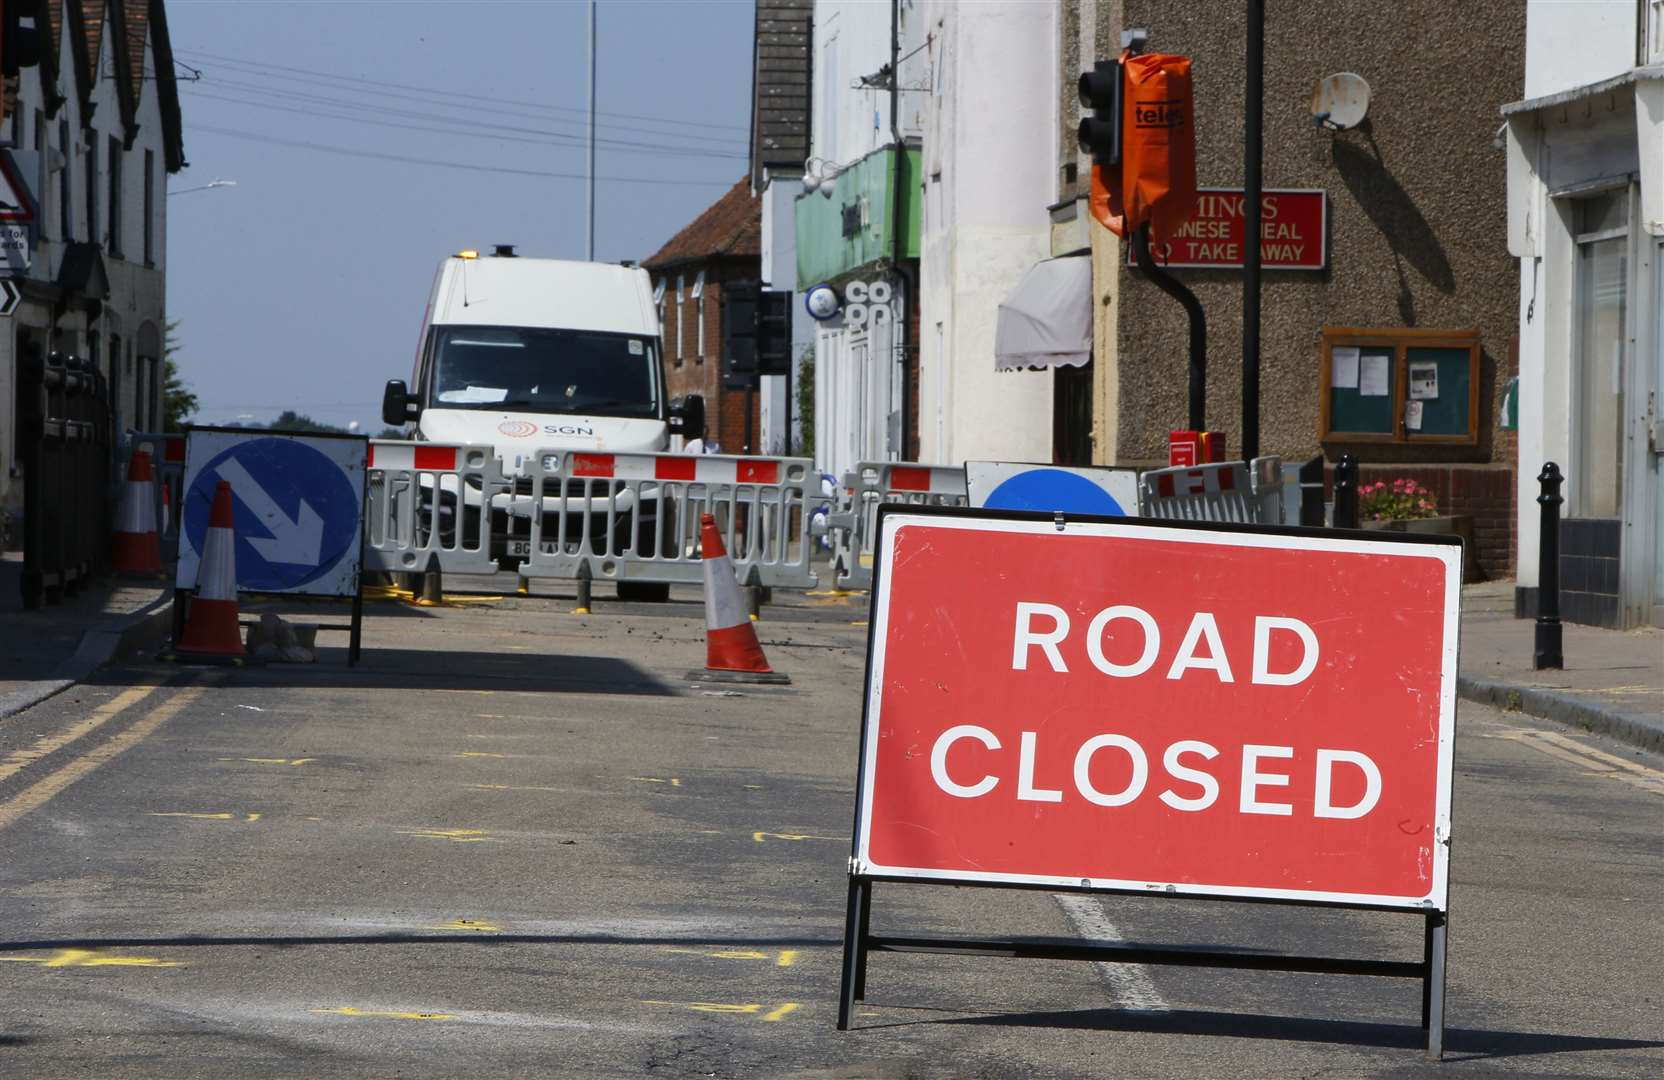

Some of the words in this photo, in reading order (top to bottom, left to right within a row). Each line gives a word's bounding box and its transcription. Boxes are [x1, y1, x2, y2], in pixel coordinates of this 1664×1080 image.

[1261, 223, 1302, 240] EAL
[0, 241, 24, 249] ards
[1186, 242, 1238, 260] TAKE
[845, 280, 892, 303] CO
[544, 425, 593, 436] SGN
[1012, 601, 1319, 686] ROAD
[930, 725, 1382, 819] CLOSED
